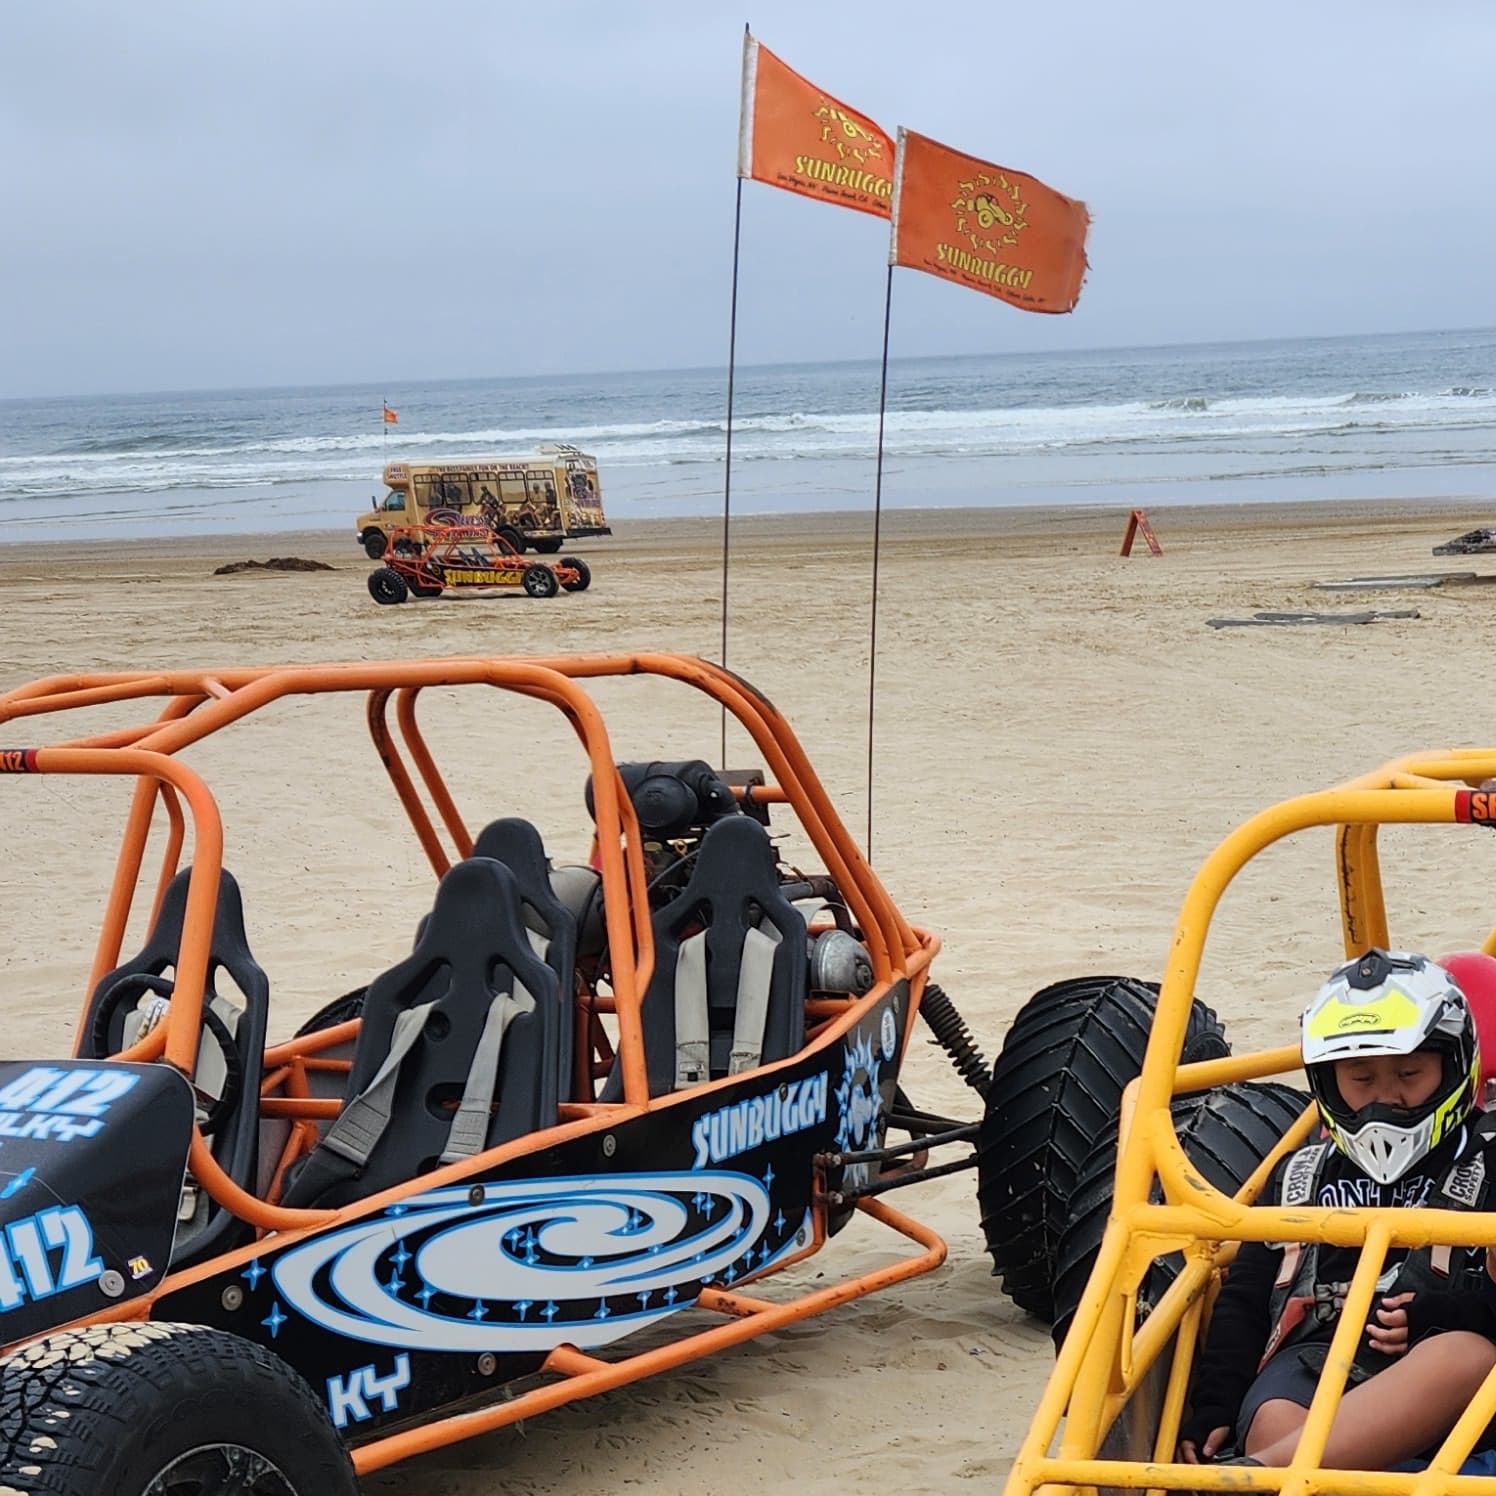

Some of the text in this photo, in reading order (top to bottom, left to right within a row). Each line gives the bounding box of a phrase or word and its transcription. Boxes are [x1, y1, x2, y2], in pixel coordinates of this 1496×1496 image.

[936, 242, 1033, 289] SUNBUGGY
[443, 568, 524, 586] SUNBUGG
[692, 1070, 828, 1170] SUNBUGGY
